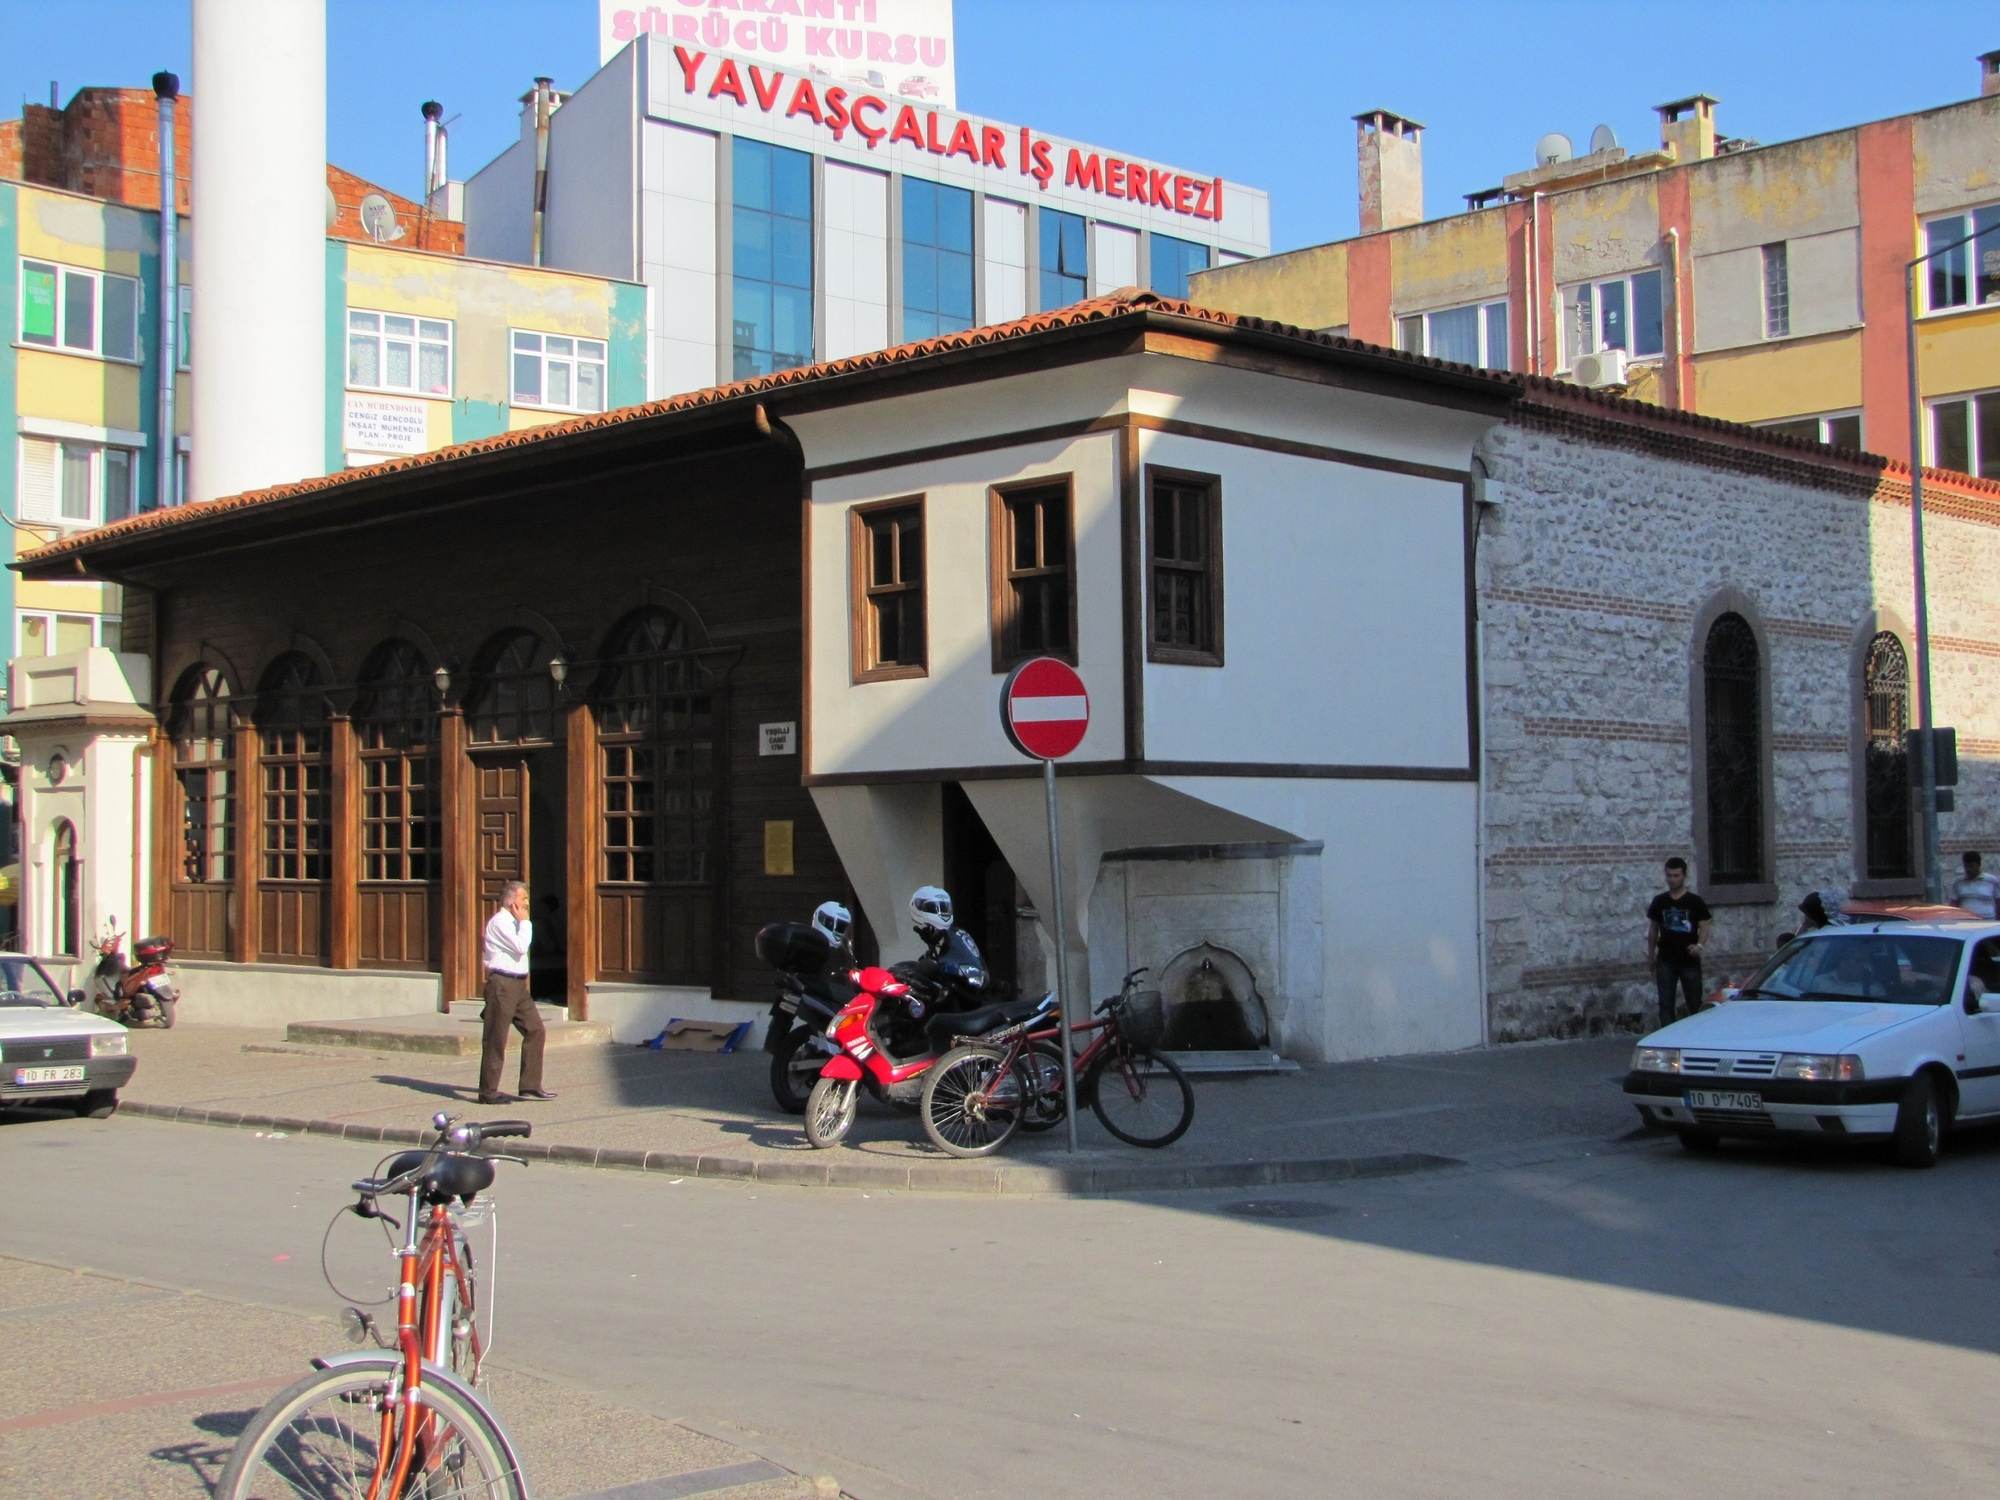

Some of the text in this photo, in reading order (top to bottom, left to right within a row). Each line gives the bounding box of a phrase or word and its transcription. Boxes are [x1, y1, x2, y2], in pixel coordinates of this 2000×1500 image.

[612, 7, 947, 68] SÜRÜCÜ KURSU
[673, 45, 1224, 221] YAVAŞÇALAR İŞ MERKEZİ
[44, 1069, 57, 1080] FR
[63, 1068, 82, 1079] 283
[1691, 1092, 1760, 1109] 10 D 7405
